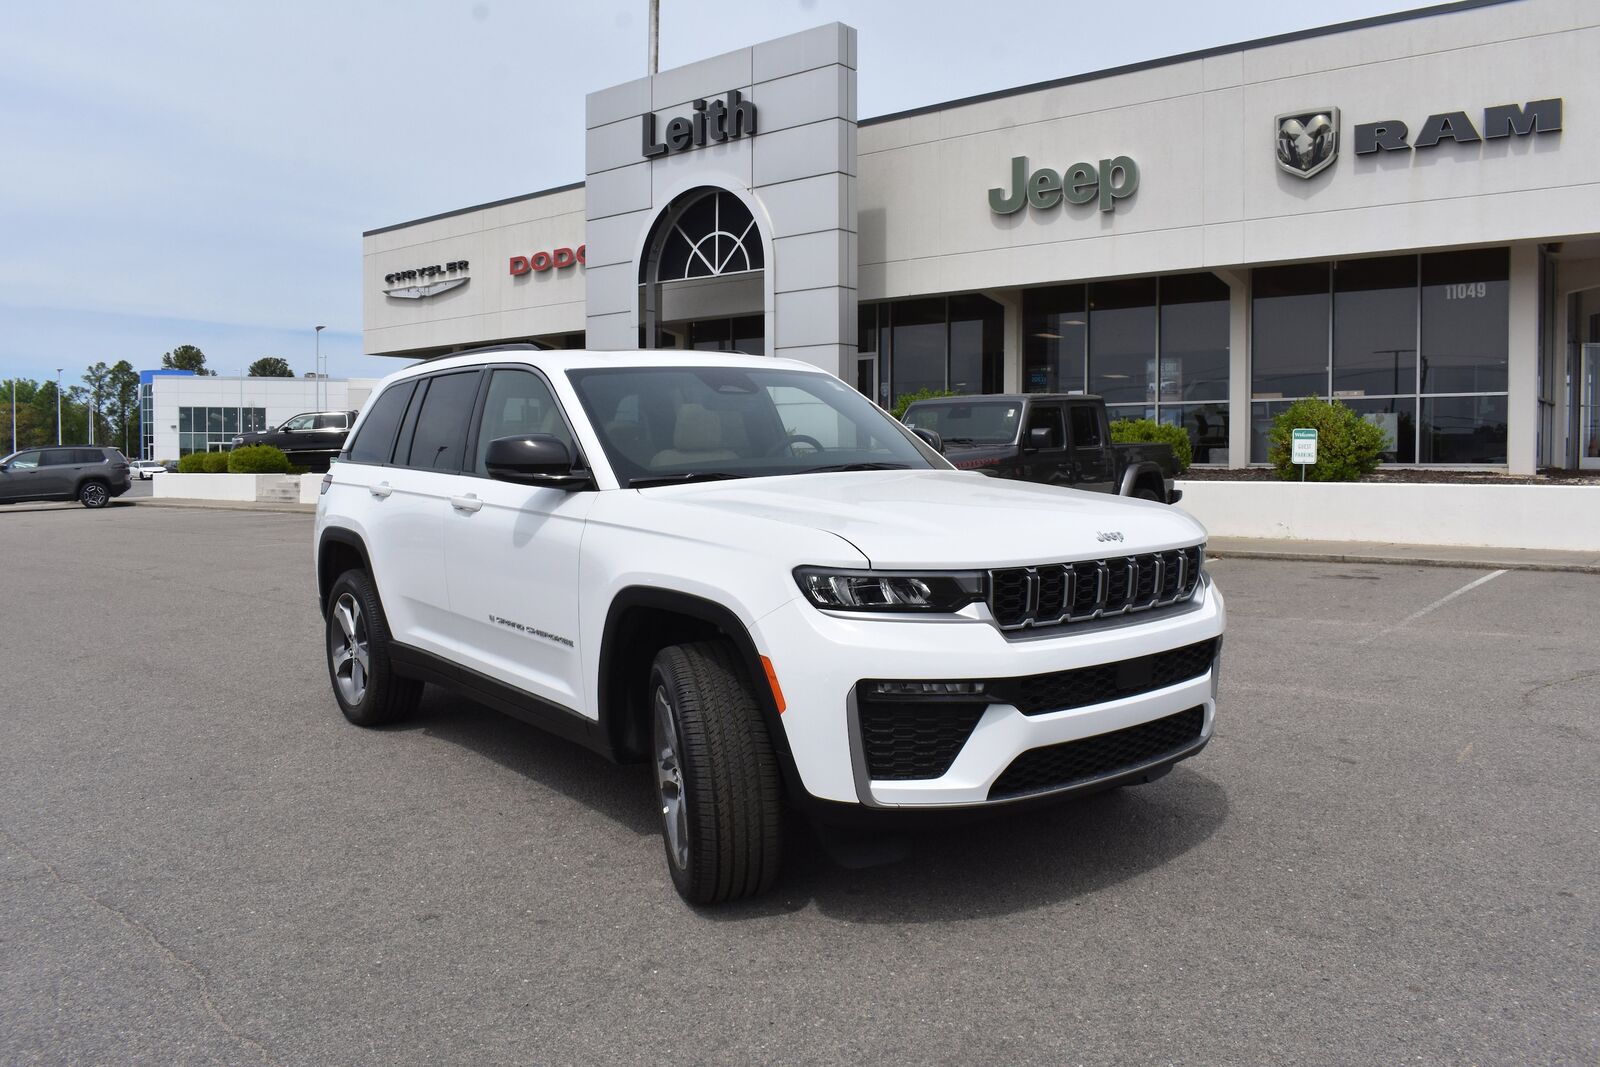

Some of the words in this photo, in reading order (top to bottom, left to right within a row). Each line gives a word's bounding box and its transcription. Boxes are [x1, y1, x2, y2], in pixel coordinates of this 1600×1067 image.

[642, 89, 757, 157] Leith
[1354, 98, 1562, 156] RAM
[988, 156, 1140, 213] Jeep
[385, 260, 469, 283] CHRYSLER
[1445, 282, 1486, 299] 11049
[1096, 530, 1124, 543] Jeep
